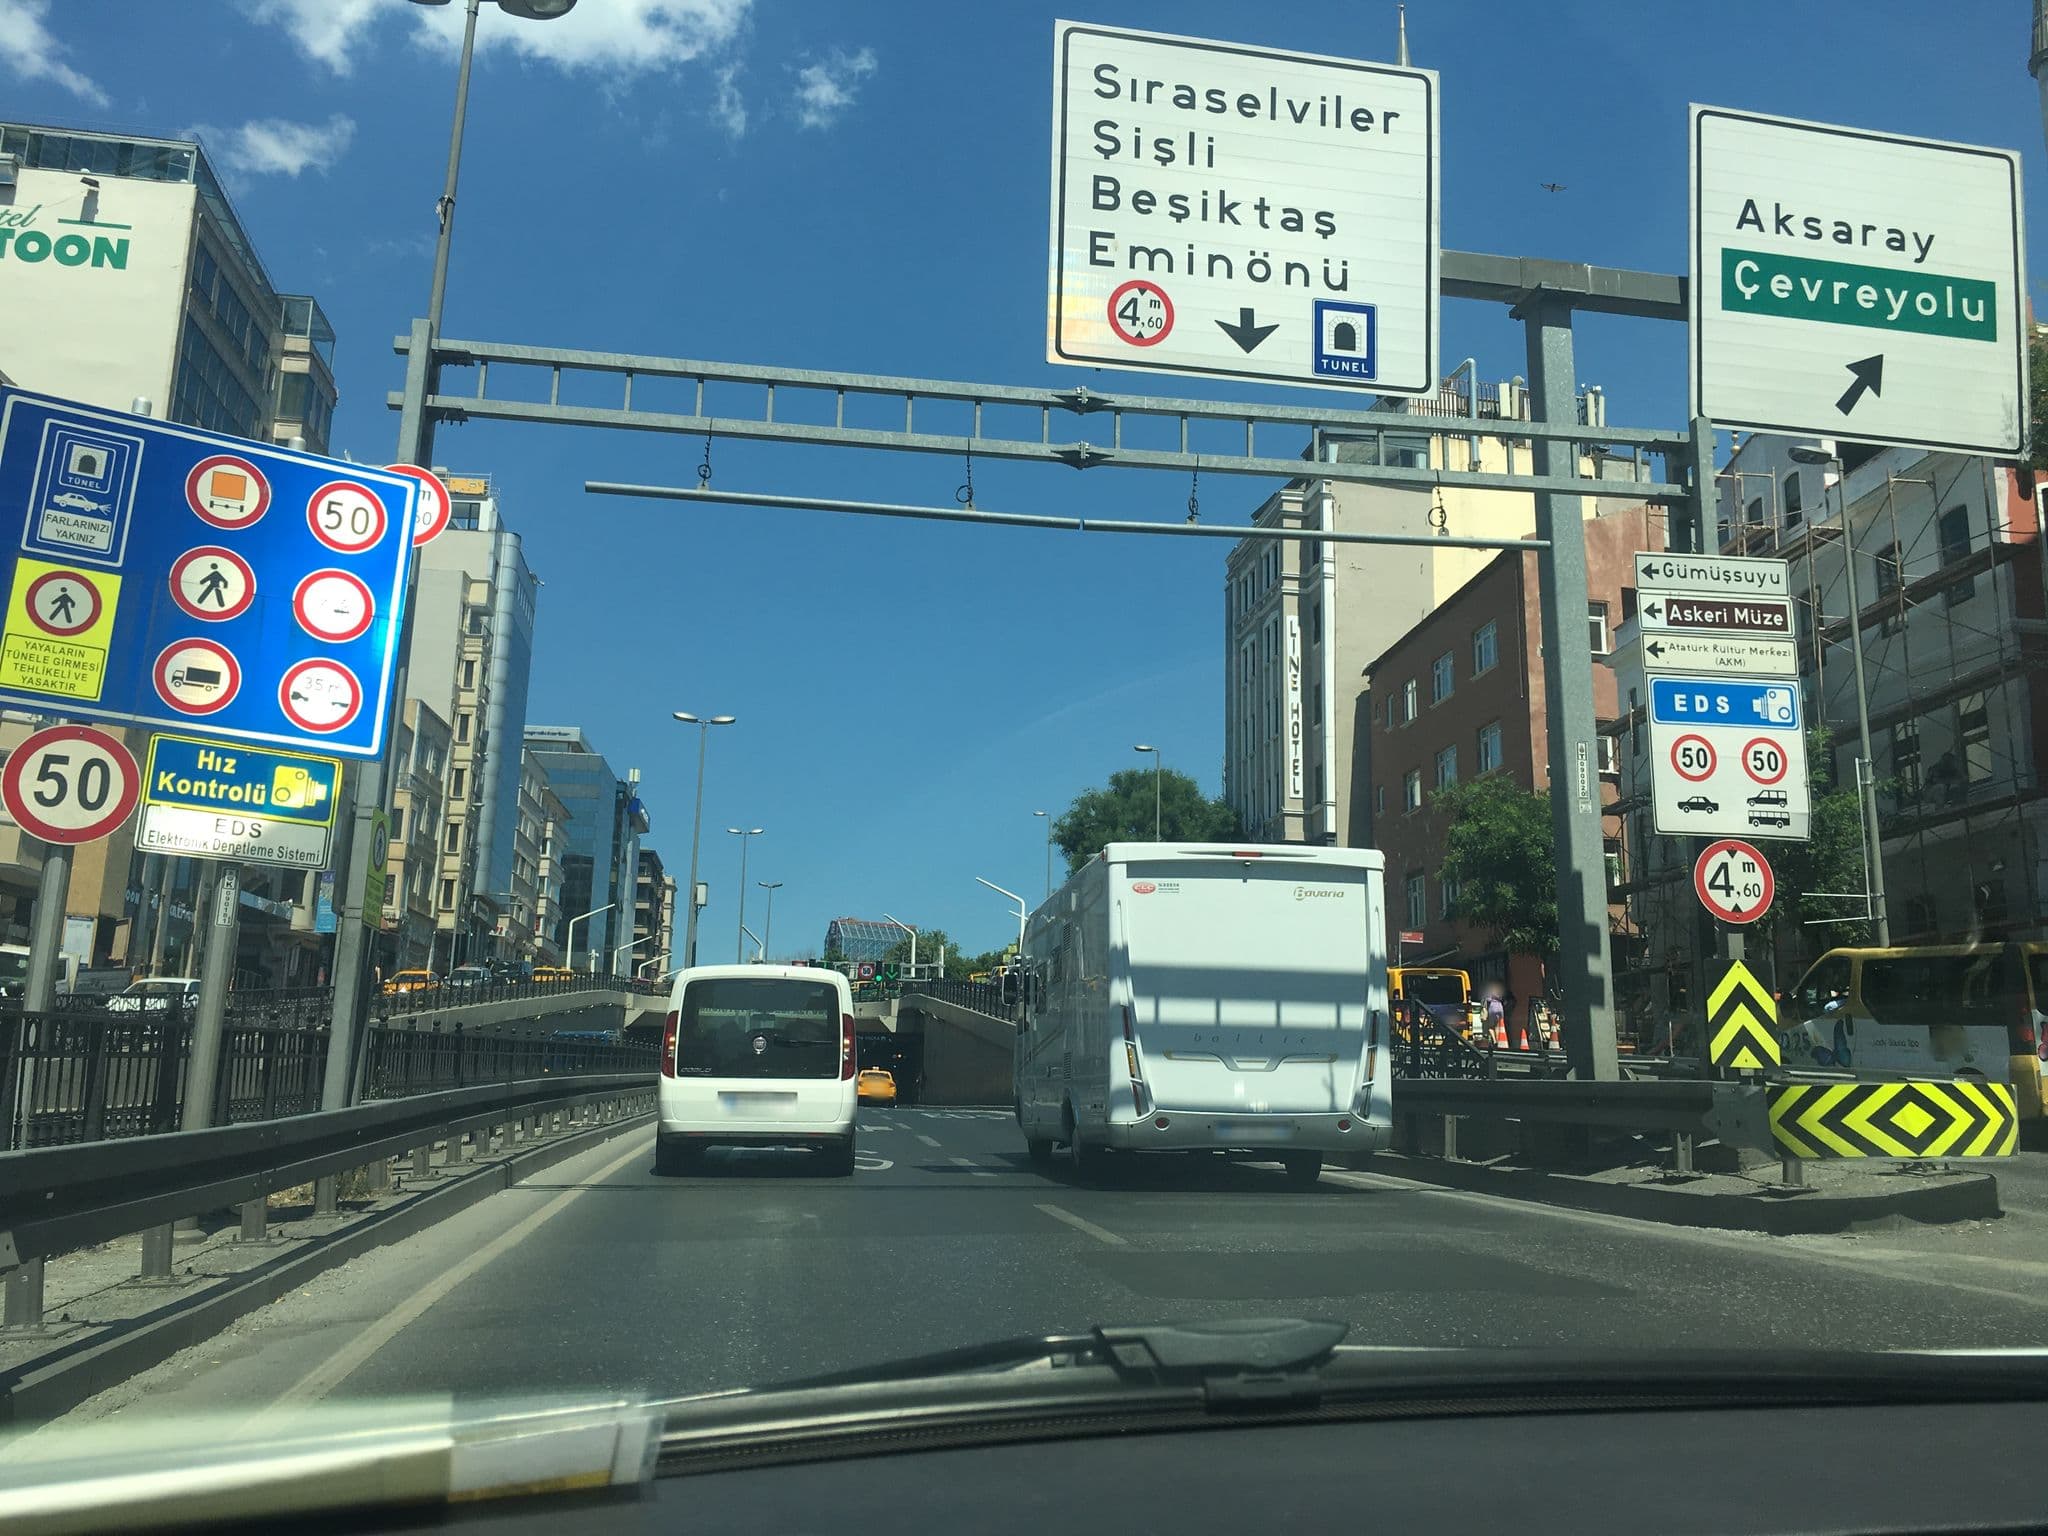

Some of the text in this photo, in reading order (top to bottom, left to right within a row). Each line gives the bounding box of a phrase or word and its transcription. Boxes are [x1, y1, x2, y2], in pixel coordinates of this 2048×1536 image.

[1093, 63, 1400, 135] Sıraselviler
[1093, 119, 1215, 168] Şişli
[1092, 174, 1337, 240] Beşiktaş
[1735, 198, 1935, 264] Aksaray
[1089, 230, 1349, 292] Eminönü
[1733, 259, 1985, 323] Çevreyolu
[324, 500, 370, 535] 50
[1663, 562, 1781, 588] Gümüşsuyu
[1669, 604, 1785, 627] Askeri Müze
[24, 640, 86, 659] YAYALARIN
[1715, 656, 1747, 669] (AKM)
[20, 675, 77, 692] YASAKTIR
[73, 671, 89, 683] VE
[1674, 694, 1731, 714] EDS
[197, 749, 238, 774] Hız
[1291, 702, 1301, 795] HOTEL
[1681, 746, 1779, 773] 50 50
[33, 753, 111, 811] 50
[157, 770, 267, 805] Kontrolü
[214, 817, 263, 839] EDS
[276, 845, 321, 863] Sistemi
